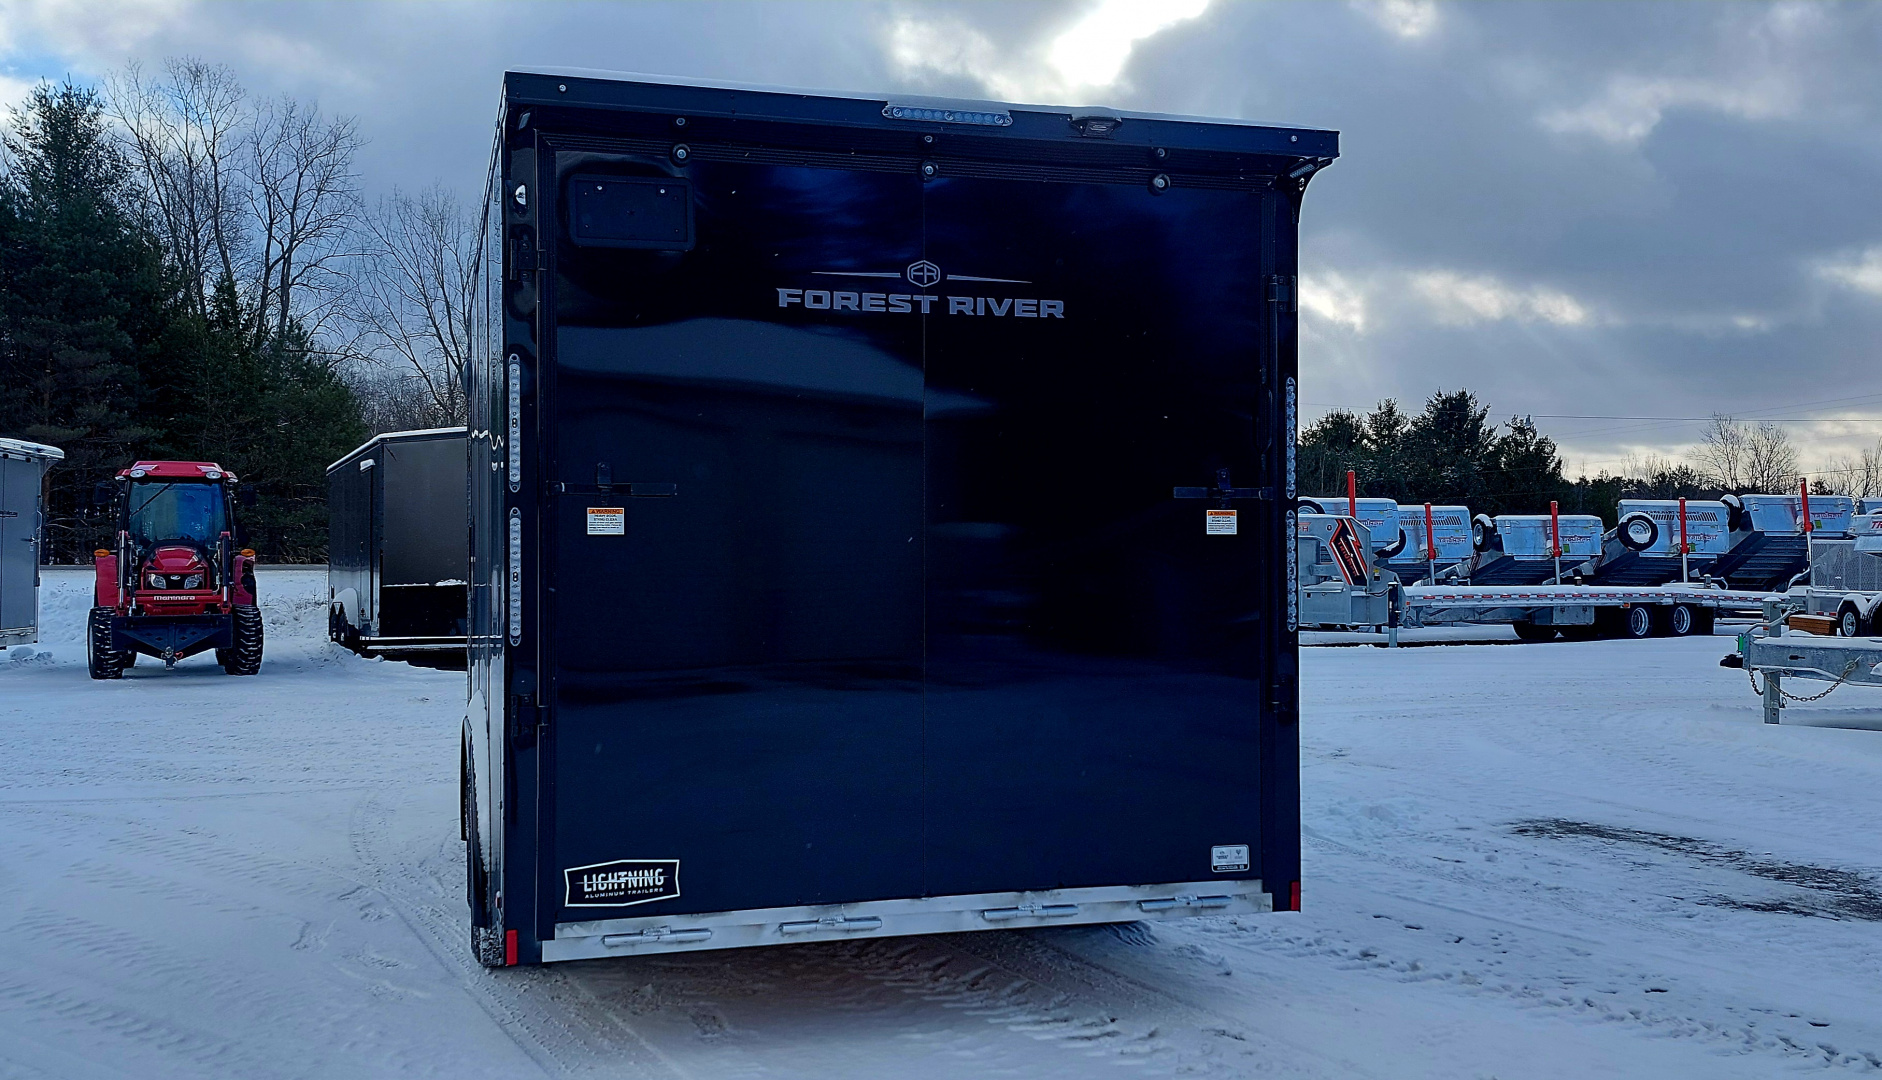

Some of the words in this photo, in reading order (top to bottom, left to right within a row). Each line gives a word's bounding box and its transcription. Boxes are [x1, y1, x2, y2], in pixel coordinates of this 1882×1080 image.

[776, 288, 939, 314] FOREST
[947, 296, 1065, 319] RIVER
[583, 868, 665, 892] LIGHTNING
[584, 891, 625, 899] ALUMINUM
[627, 887, 664, 895] TRAILERS
